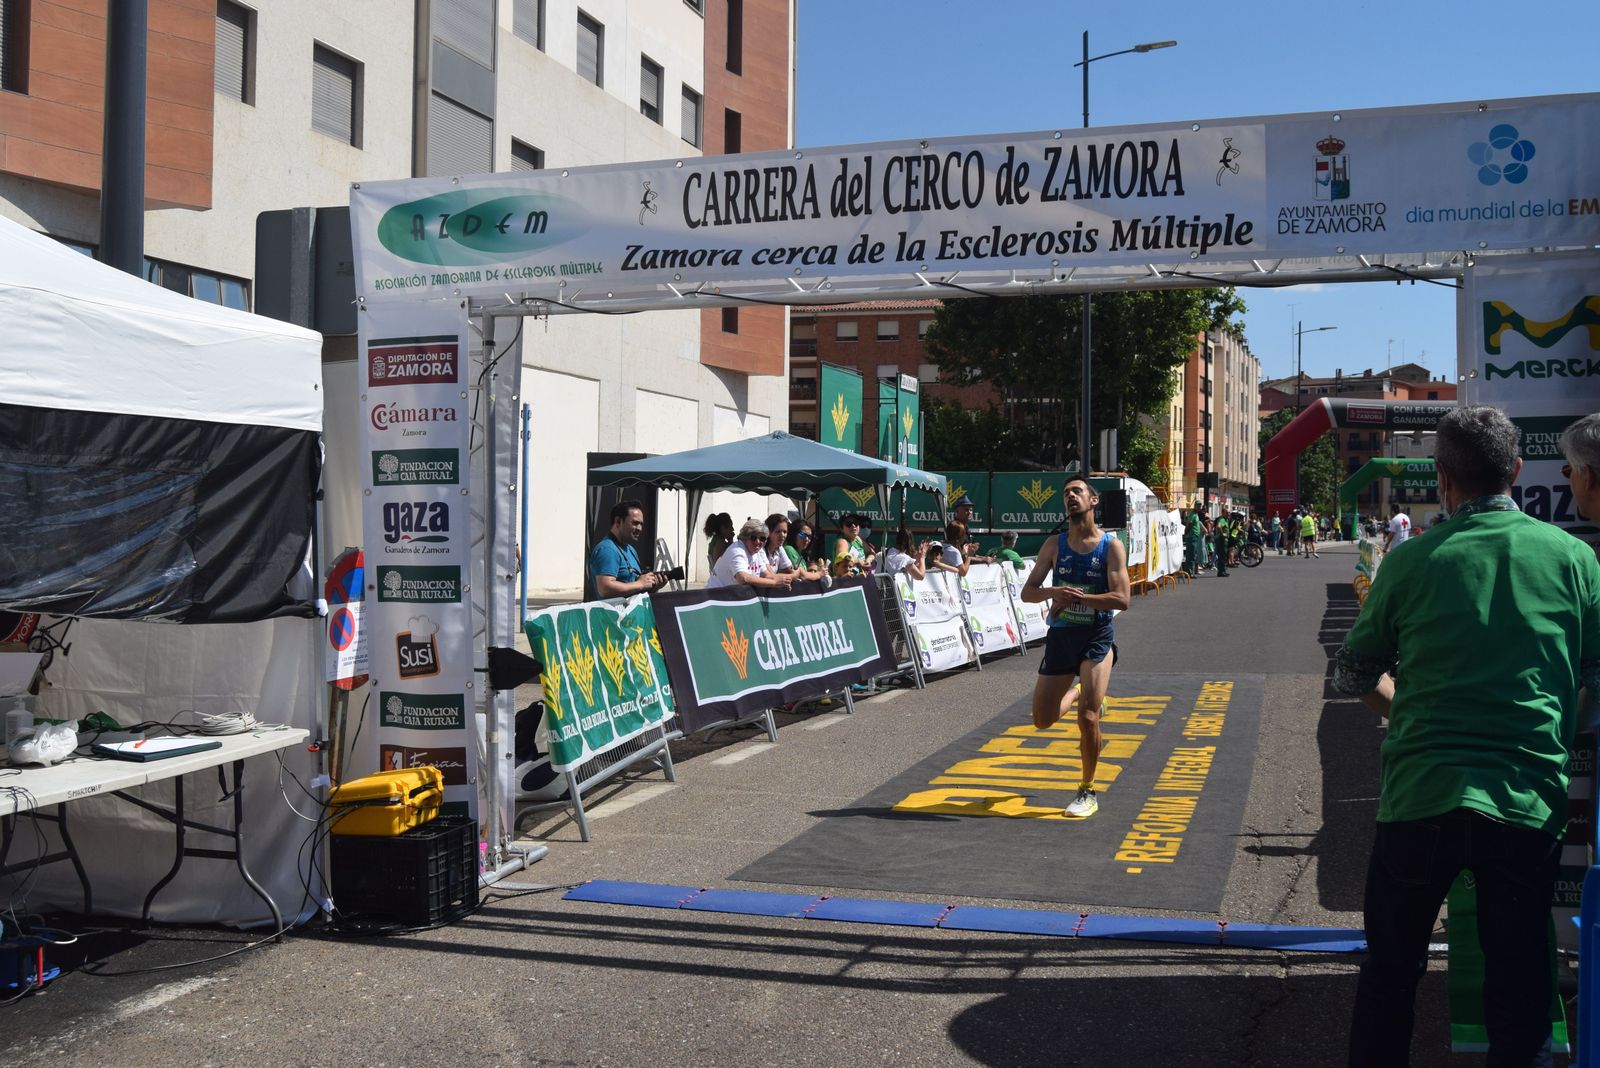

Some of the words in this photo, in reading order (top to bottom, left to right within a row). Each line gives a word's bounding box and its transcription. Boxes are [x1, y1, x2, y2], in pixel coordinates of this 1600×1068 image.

[682, 163, 821, 229] CARRERA
[830, 155, 873, 219] del
[882, 149, 985, 215] CERCO
[995, 146, 1030, 205] de
[1040, 138, 1185, 203] ZAMORA
[1278, 202, 1386, 218] AYUNTAMIENTO
[1438, 200, 1515, 222] mundial
[1568, 198, 1600, 216] EM
[1278, 218, 1300, 235] DE
[1304, 216, 1386, 234] ZAMORA
[620, 244, 742, 271] Zamora
[751, 244, 844, 266] cerca
[847, 234, 885, 265] de
[898, 231, 926, 262] la
[935, 221, 1099, 260] Esclerosis
[1109, 213, 1254, 256] Múltiple
[374, 273, 427, 290] ASOCIACIÓN
[430, 270, 482, 285] ZAMORANA
[486, 268, 500, 282] DE
[502, 264, 556, 281] ESCLEROSIS
[559, 260, 603, 276] MÚLTIPLE
[387, 352, 438, 363] DIPUTACIÓN
[439, 352, 453, 361] DE
[387, 362, 454, 378] ZAMORA
[1392, 405, 1413, 414] CON
[1415, 406, 1425, 414] EL
[1392, 416, 1437, 425] GANAMOS
[402, 428, 427, 437] Zamora
[1526, 444, 1559, 456] CAJA
[400, 461, 454, 471] FUNDACION
[1407, 463, 1431, 472] CAJA
[400, 471, 418, 481] CAJA
[418, 471, 454, 481] RURAL
[912, 511, 940, 521] CAJA
[1001, 512, 1030, 523] CAJA
[382, 501, 450, 544] gaza
[421, 545, 450, 554] Zamora
[402, 580, 456, 590] FUNDACION
[402, 589, 419, 599] CAJA
[420, 589, 456, 599] RURAL
[753, 627, 800, 671] CAJA
[794, 618, 855, 663] RURAL
[400, 644, 434, 668] Susi
[403, 706, 459, 717] FUNDACION
[403, 716, 421, 726] CAJA
[423, 716, 459, 726] RURAL
[1153, 745, 1217, 792] INTEGRAL
[1114, 795, 1200, 863] REFORMA
